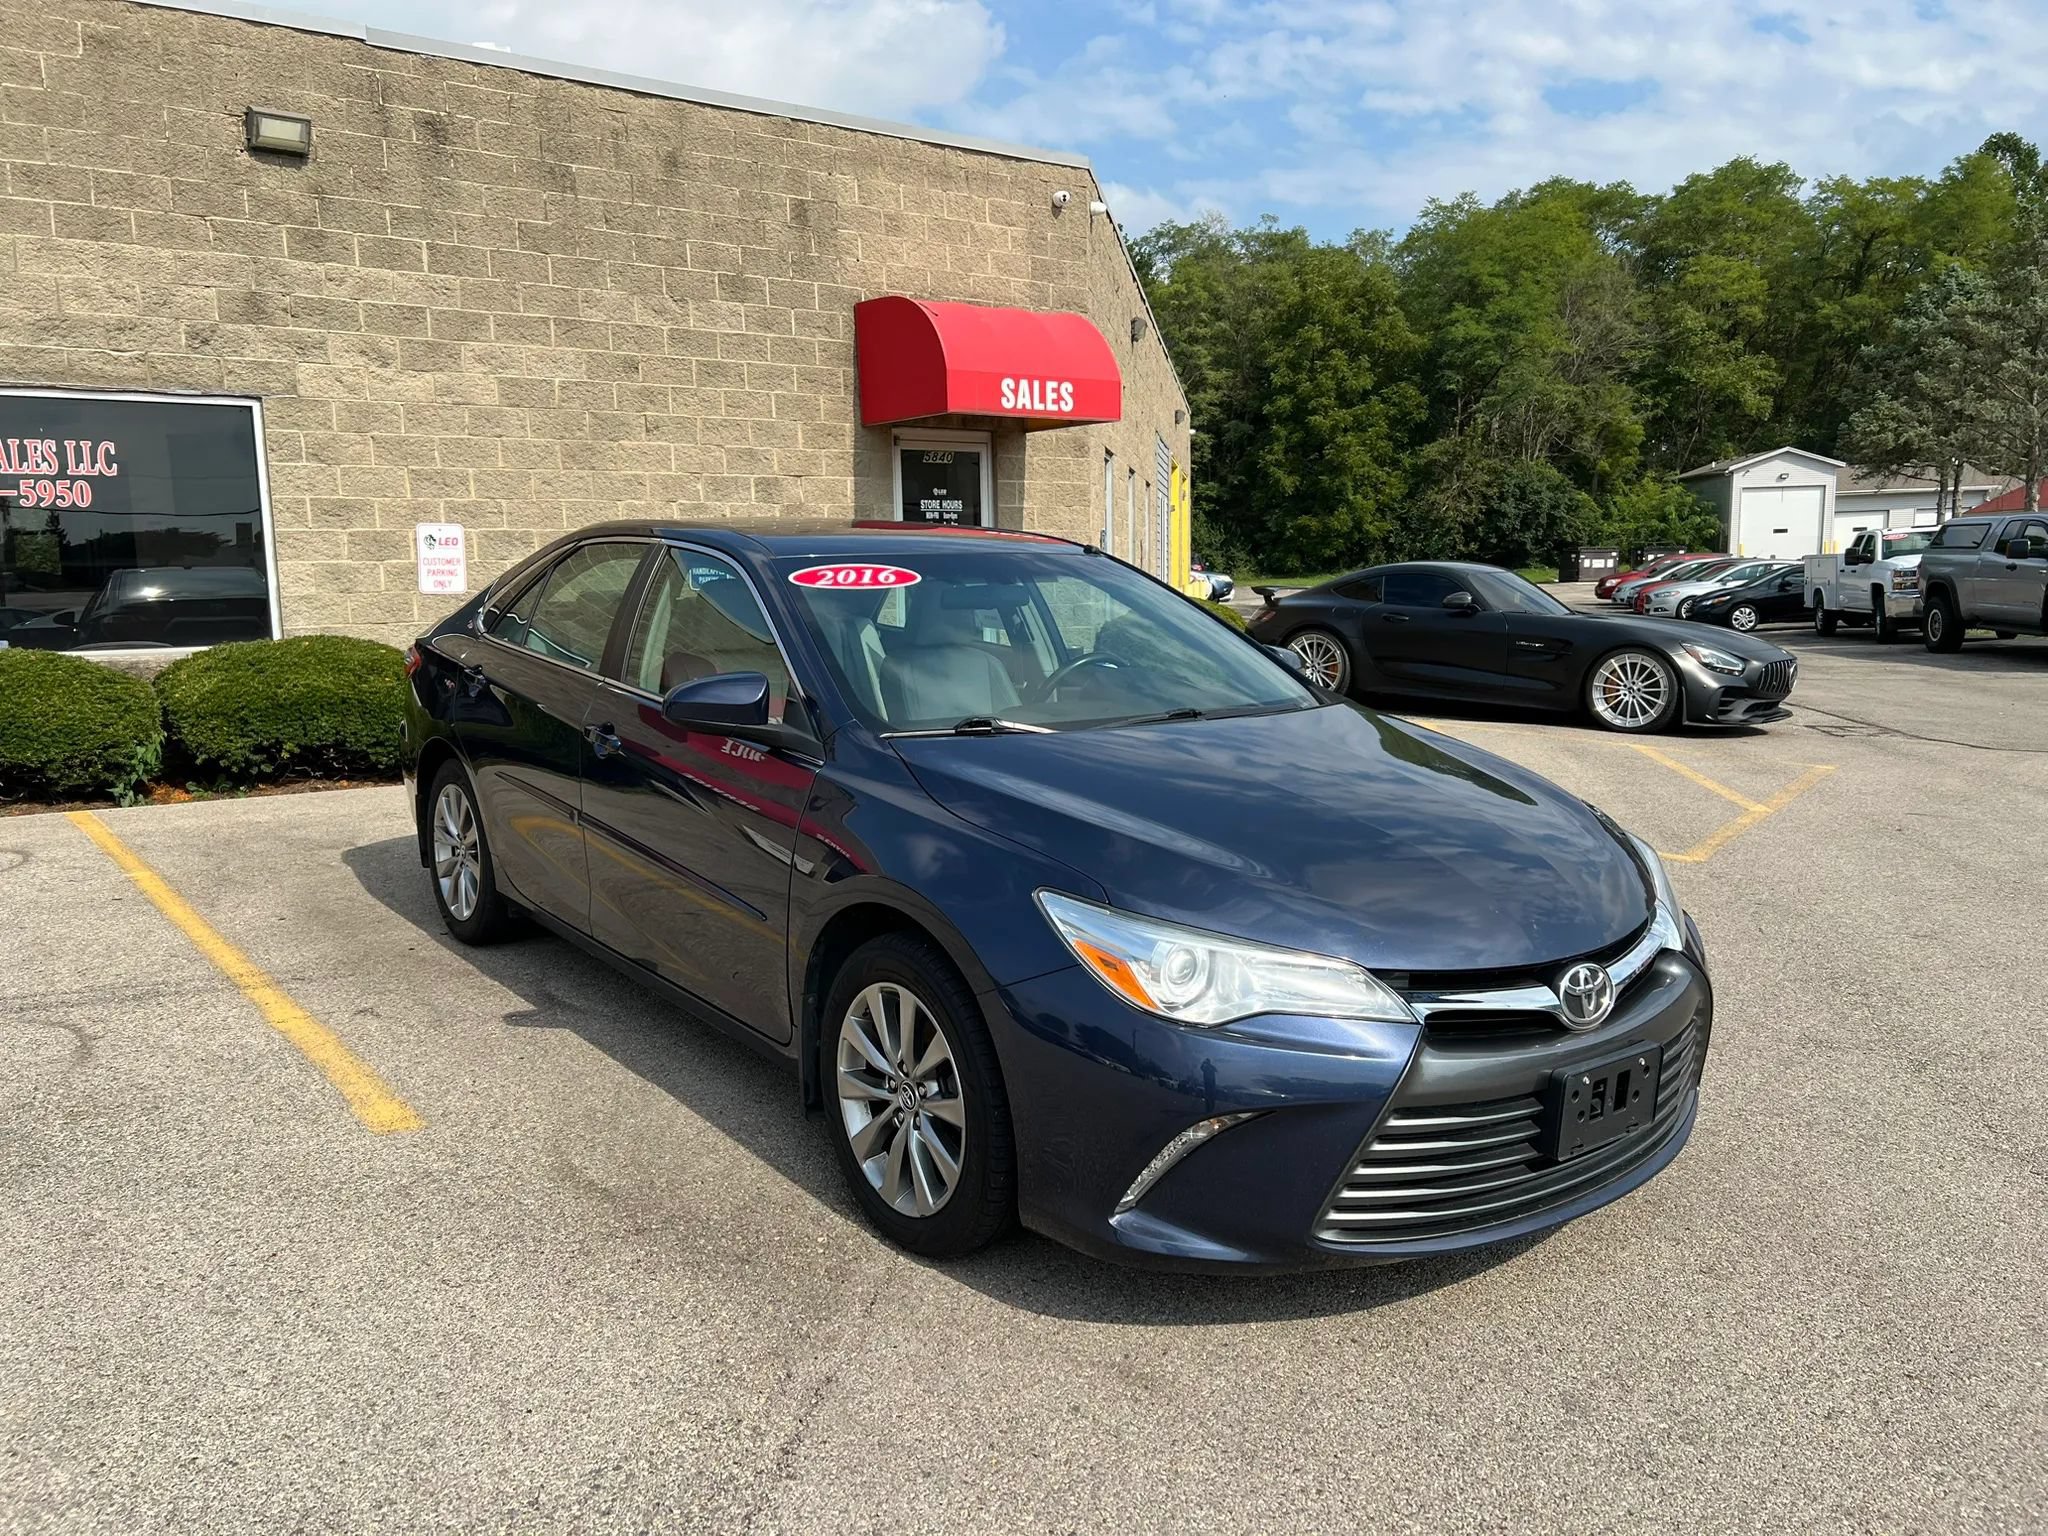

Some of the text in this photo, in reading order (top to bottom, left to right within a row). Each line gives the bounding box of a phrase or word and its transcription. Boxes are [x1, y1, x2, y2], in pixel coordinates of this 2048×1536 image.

[1000, 377, 1074, 412] SALES
[64, 440, 118, 476] LLC
[923, 451, 954, 463] 5840
[920, 500, 962, 509] STORE HOURS
[438, 537, 459, 546] LEO
[423, 558, 461, 566] CUSTOMER
[426, 568, 459, 577] PARKING
[816, 569, 897, 585] 2016
[433, 579, 452, 589] ONLY
